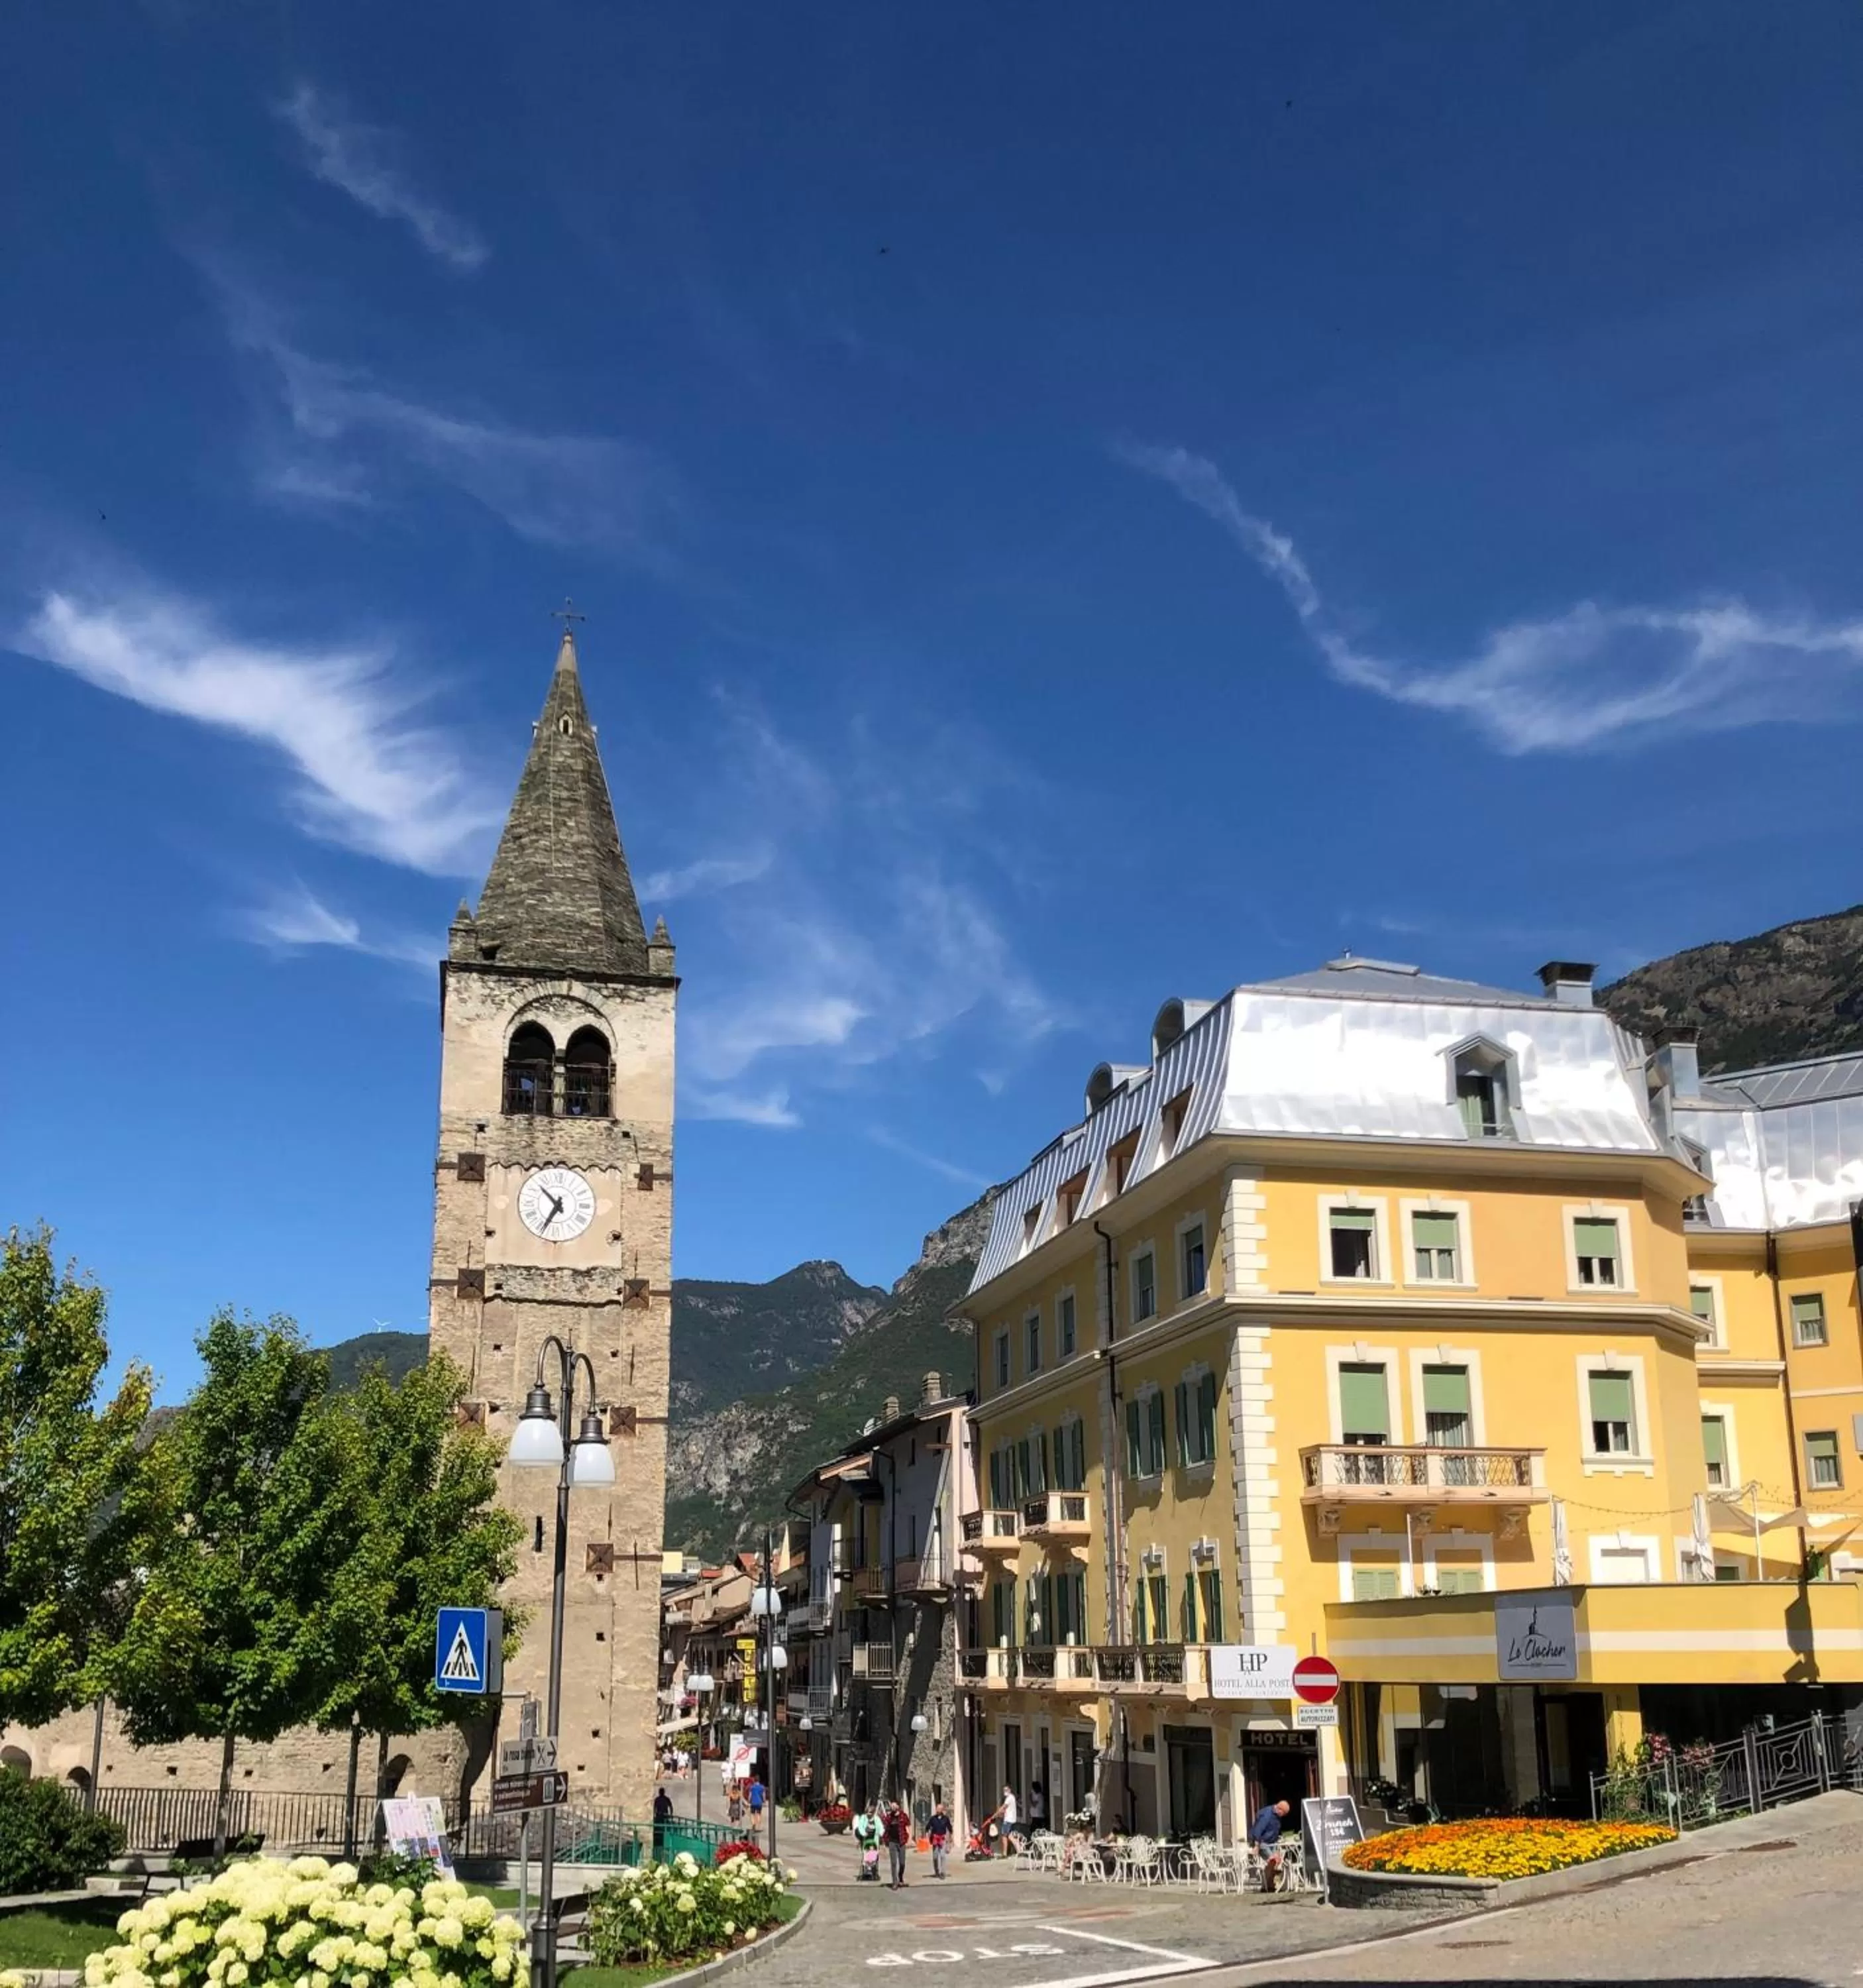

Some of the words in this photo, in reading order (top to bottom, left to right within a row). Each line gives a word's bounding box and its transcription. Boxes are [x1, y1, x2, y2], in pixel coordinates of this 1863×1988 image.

[1215, 1679, 1242, 1688] HOTEL
[1245, 1679, 1266, 1688] ALLA
[1269, 1679, 1293, 1688] POST
[1251, 1732, 1308, 1745] HOTEL
[865, 1944, 1064, 1966] STOP
